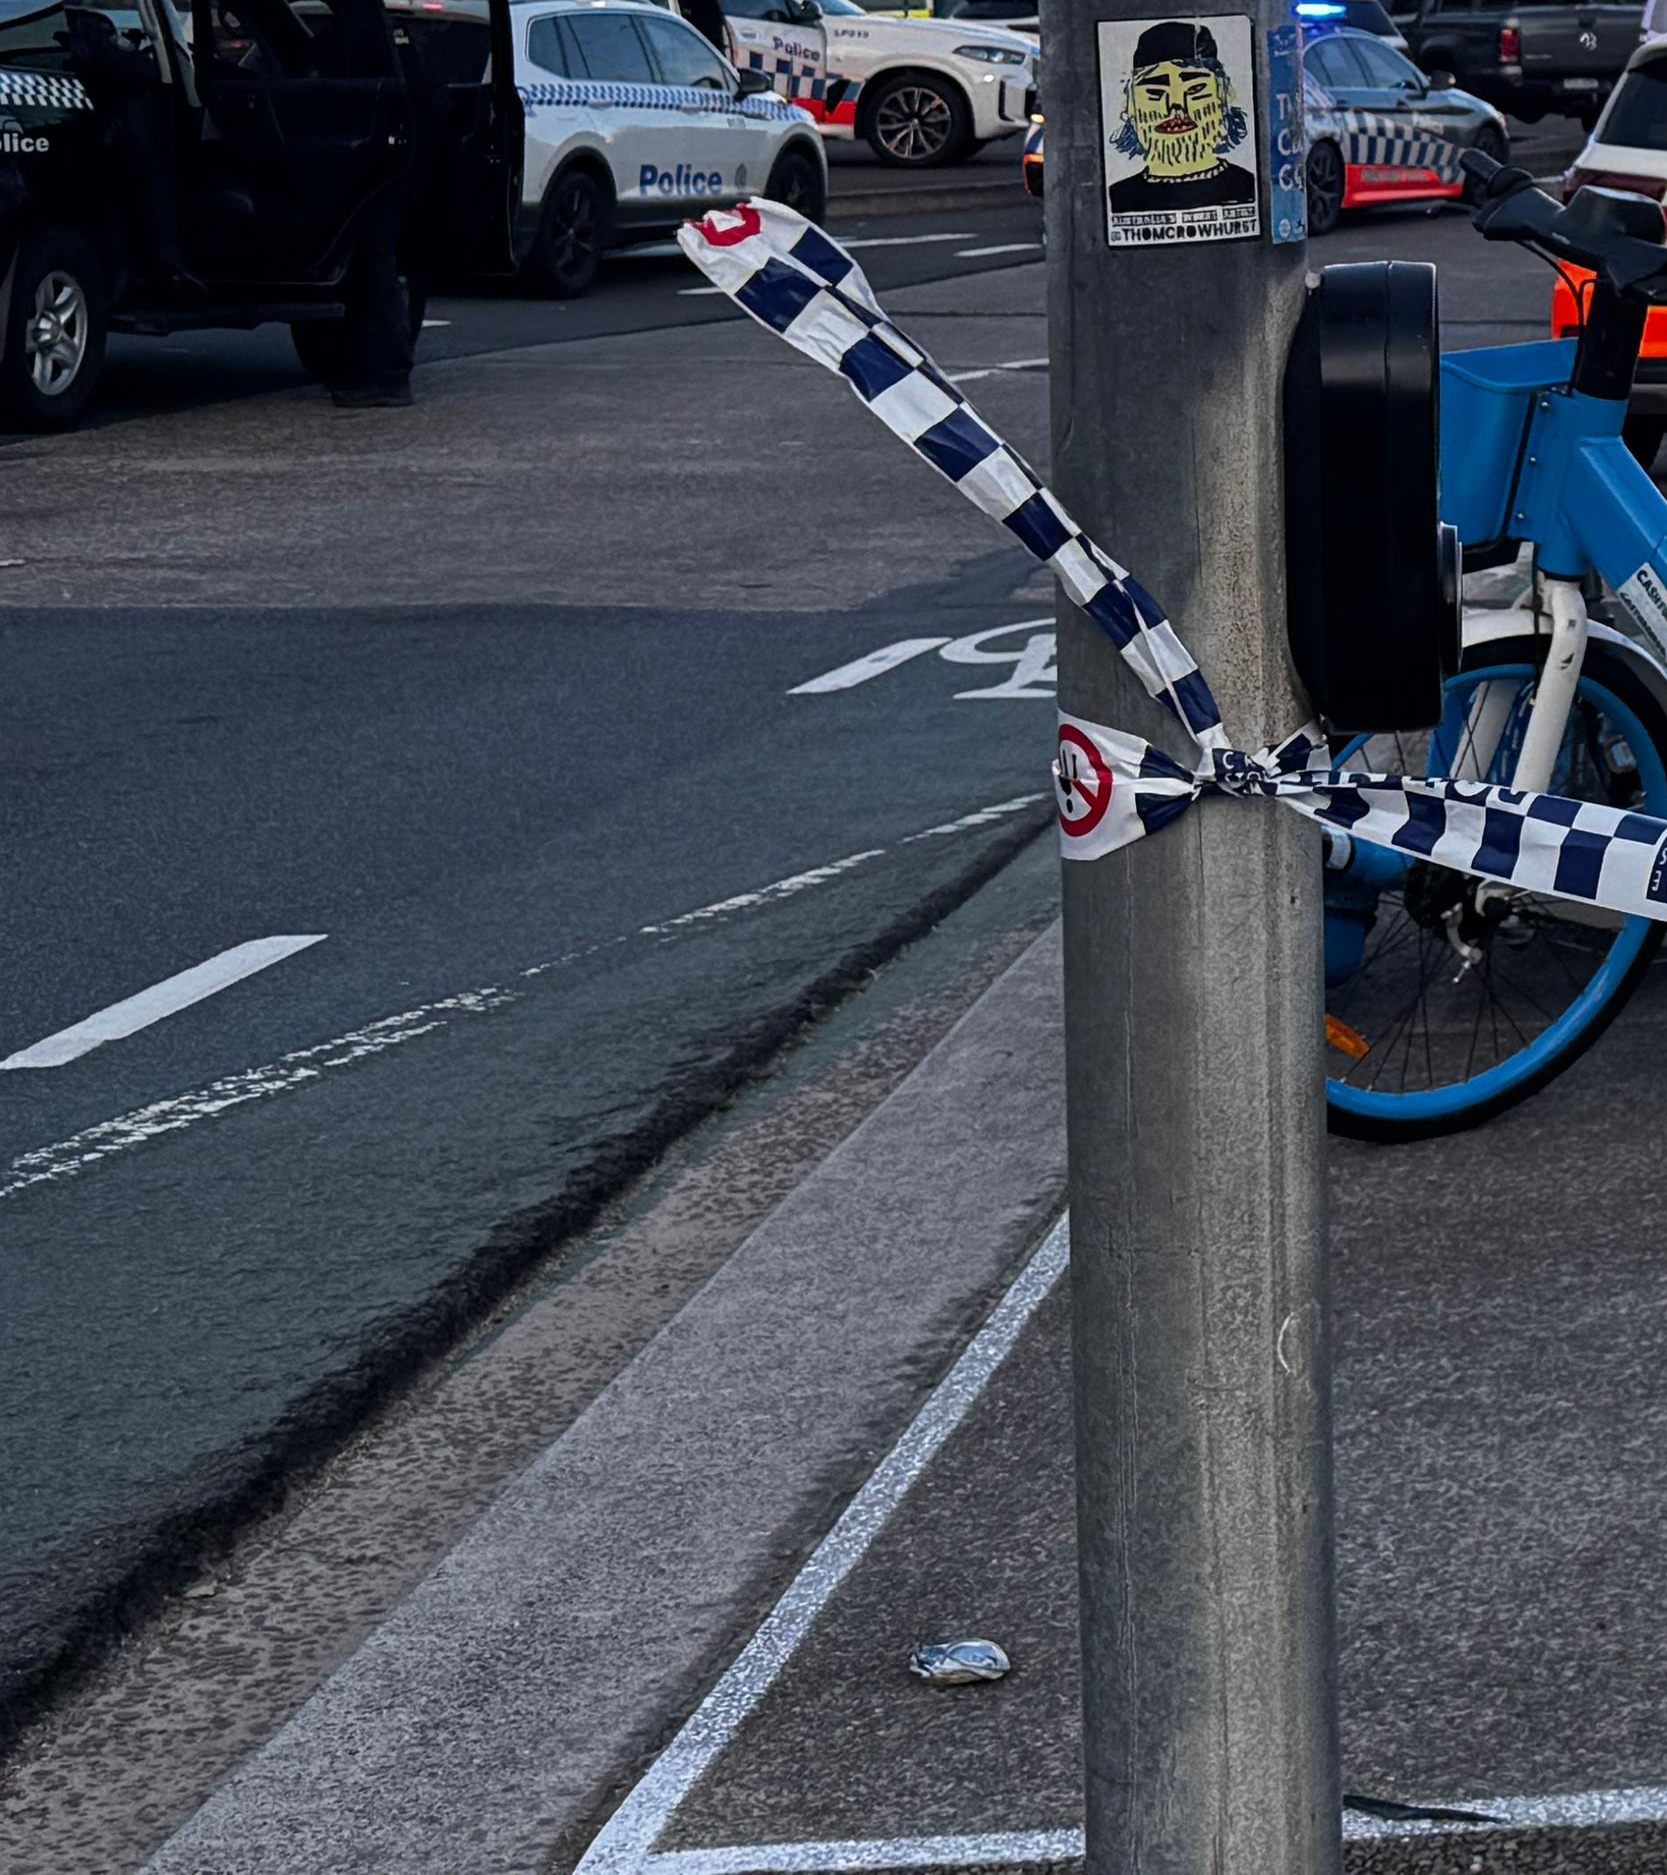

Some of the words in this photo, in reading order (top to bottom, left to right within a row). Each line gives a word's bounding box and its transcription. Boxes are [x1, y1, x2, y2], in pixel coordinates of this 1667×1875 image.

[773, 36, 820, 62] Police
[0, 133, 50, 153] lice
[640, 164, 722, 197] Police
[1122, 219, 1258, 242] THOMCROWHURST
